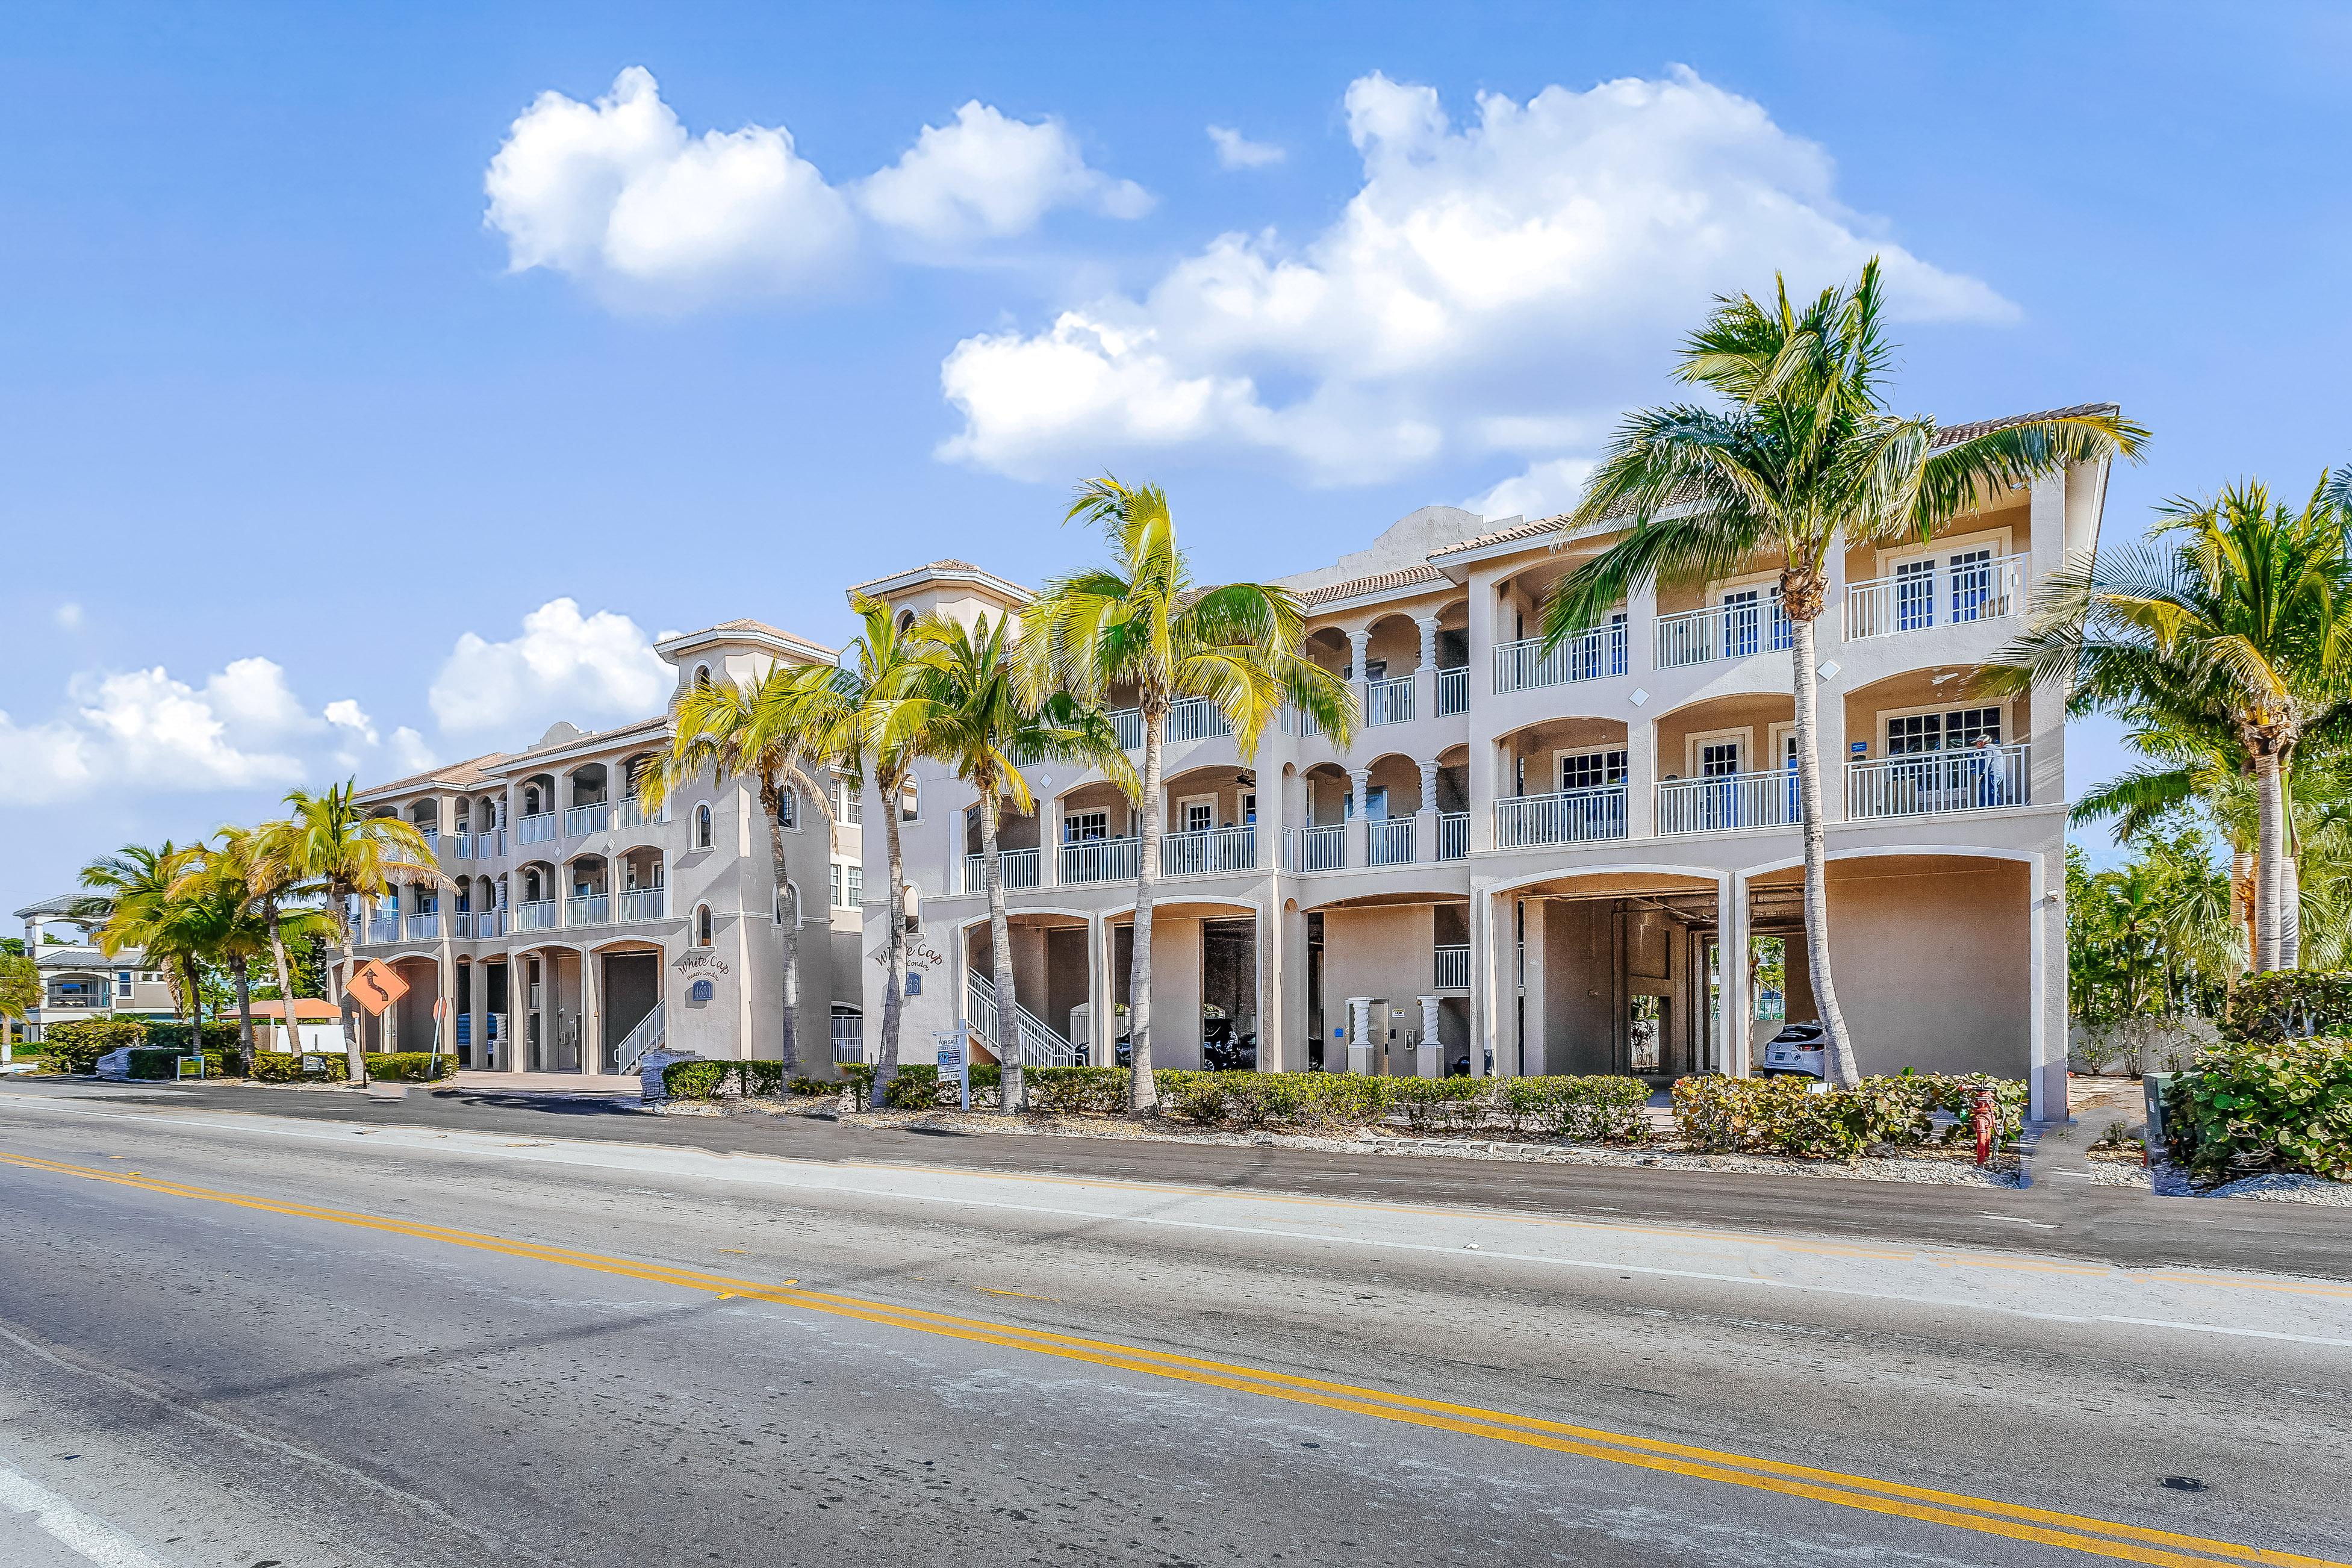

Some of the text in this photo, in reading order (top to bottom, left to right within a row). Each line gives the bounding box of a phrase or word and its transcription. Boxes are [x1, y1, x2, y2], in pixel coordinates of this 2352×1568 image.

[917, 944, 942, 965] Cap
[678, 956, 729, 975] White Cap
[907, 960, 930, 971] Condos
[687, 969, 720, 982] Beach Condos
[694, 986, 711, 998] 4631
